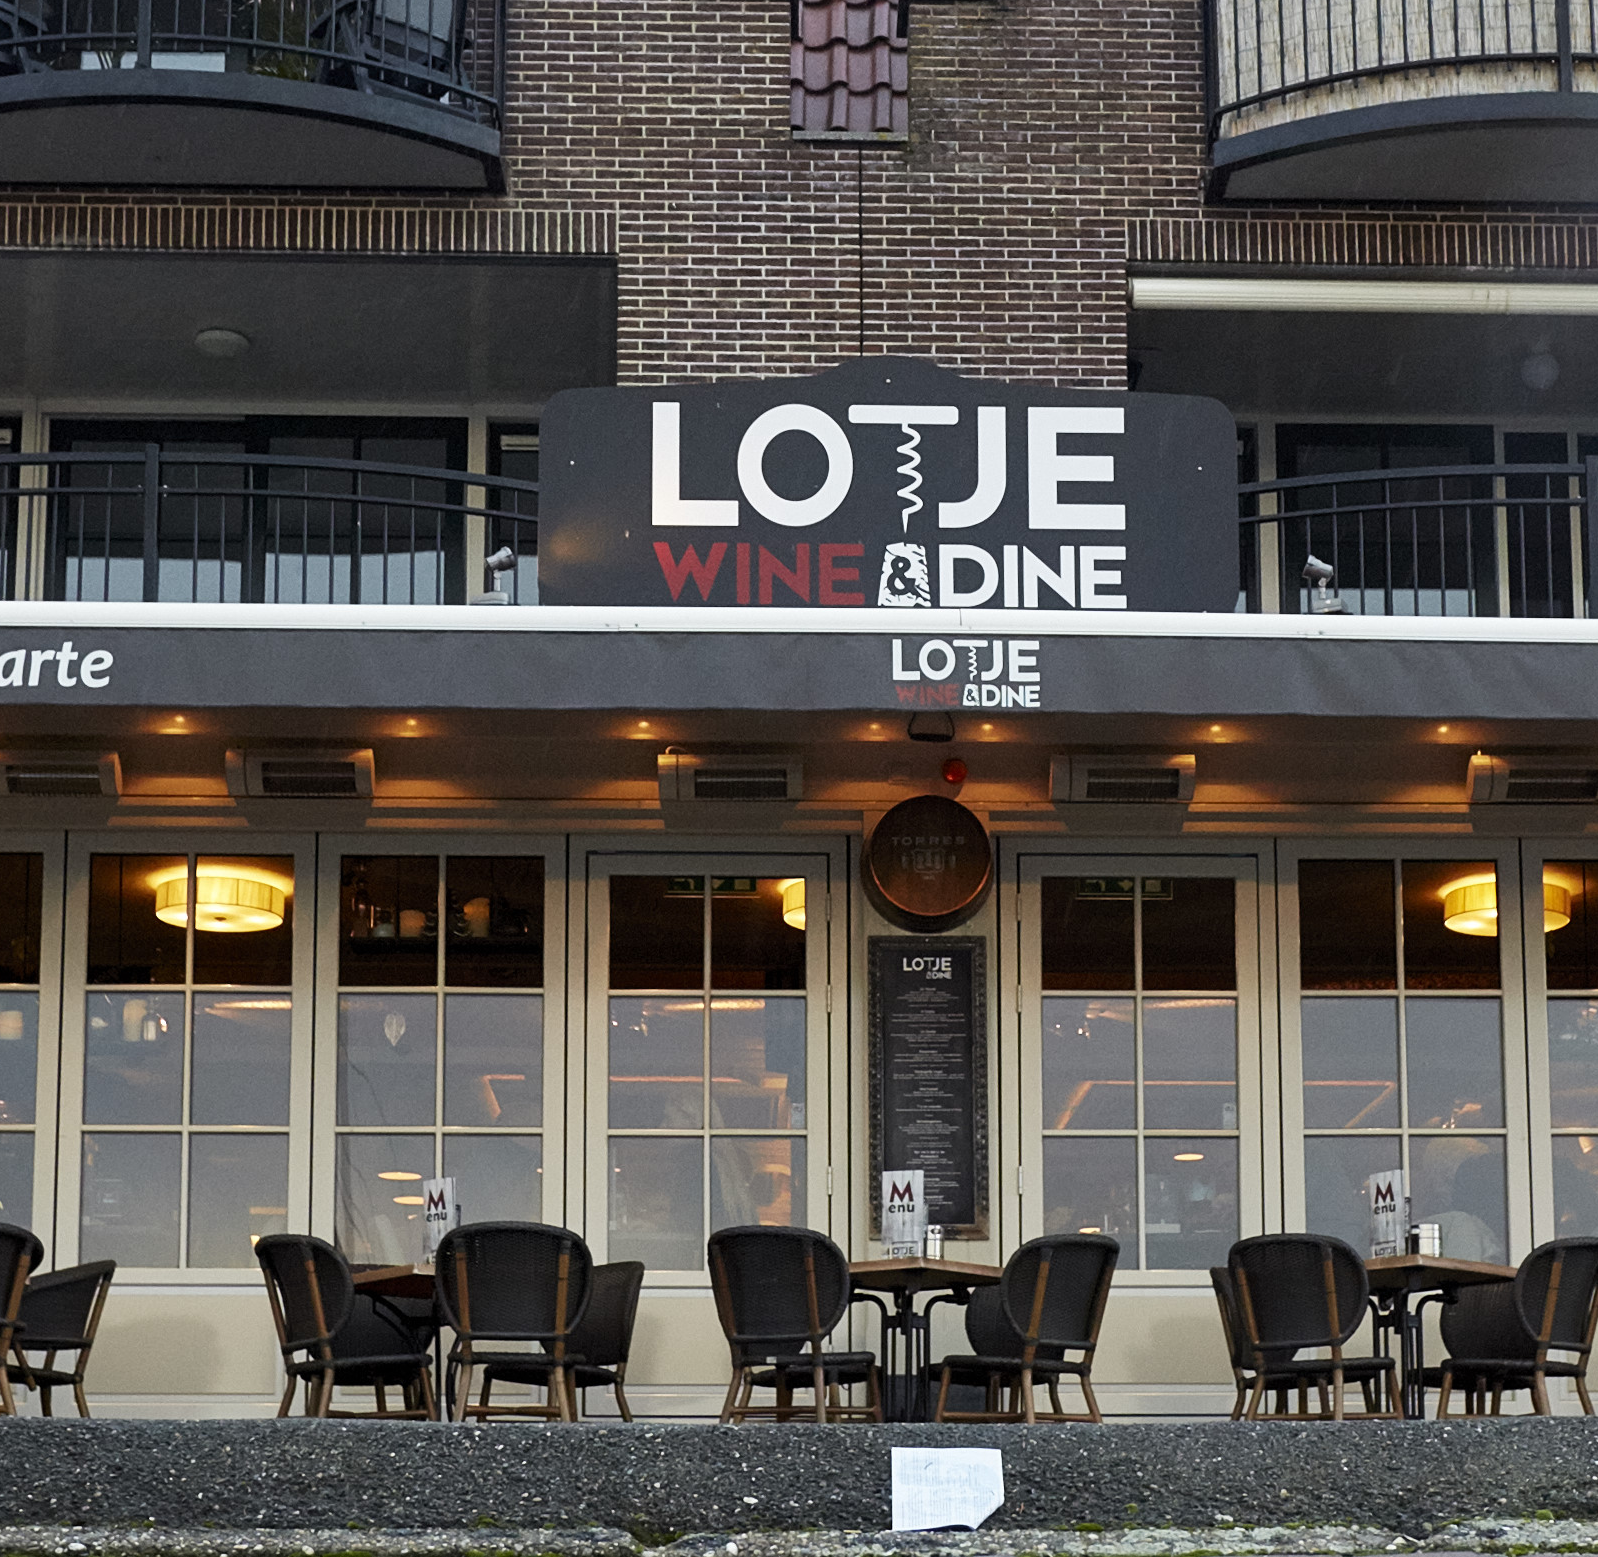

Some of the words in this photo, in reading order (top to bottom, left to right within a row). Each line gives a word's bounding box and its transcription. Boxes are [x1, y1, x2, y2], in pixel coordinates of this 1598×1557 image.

[652, 402, 1126, 532] LOTJE
[652, 542, 865, 606] WINE
[939, 544, 1127, 609] DINE
[892, 639, 1041, 682] LOTJE
[895, 684, 960, 706] WINE
[981, 684, 1041, 708] DINE
[902, 957, 952, 972] LOTJE
